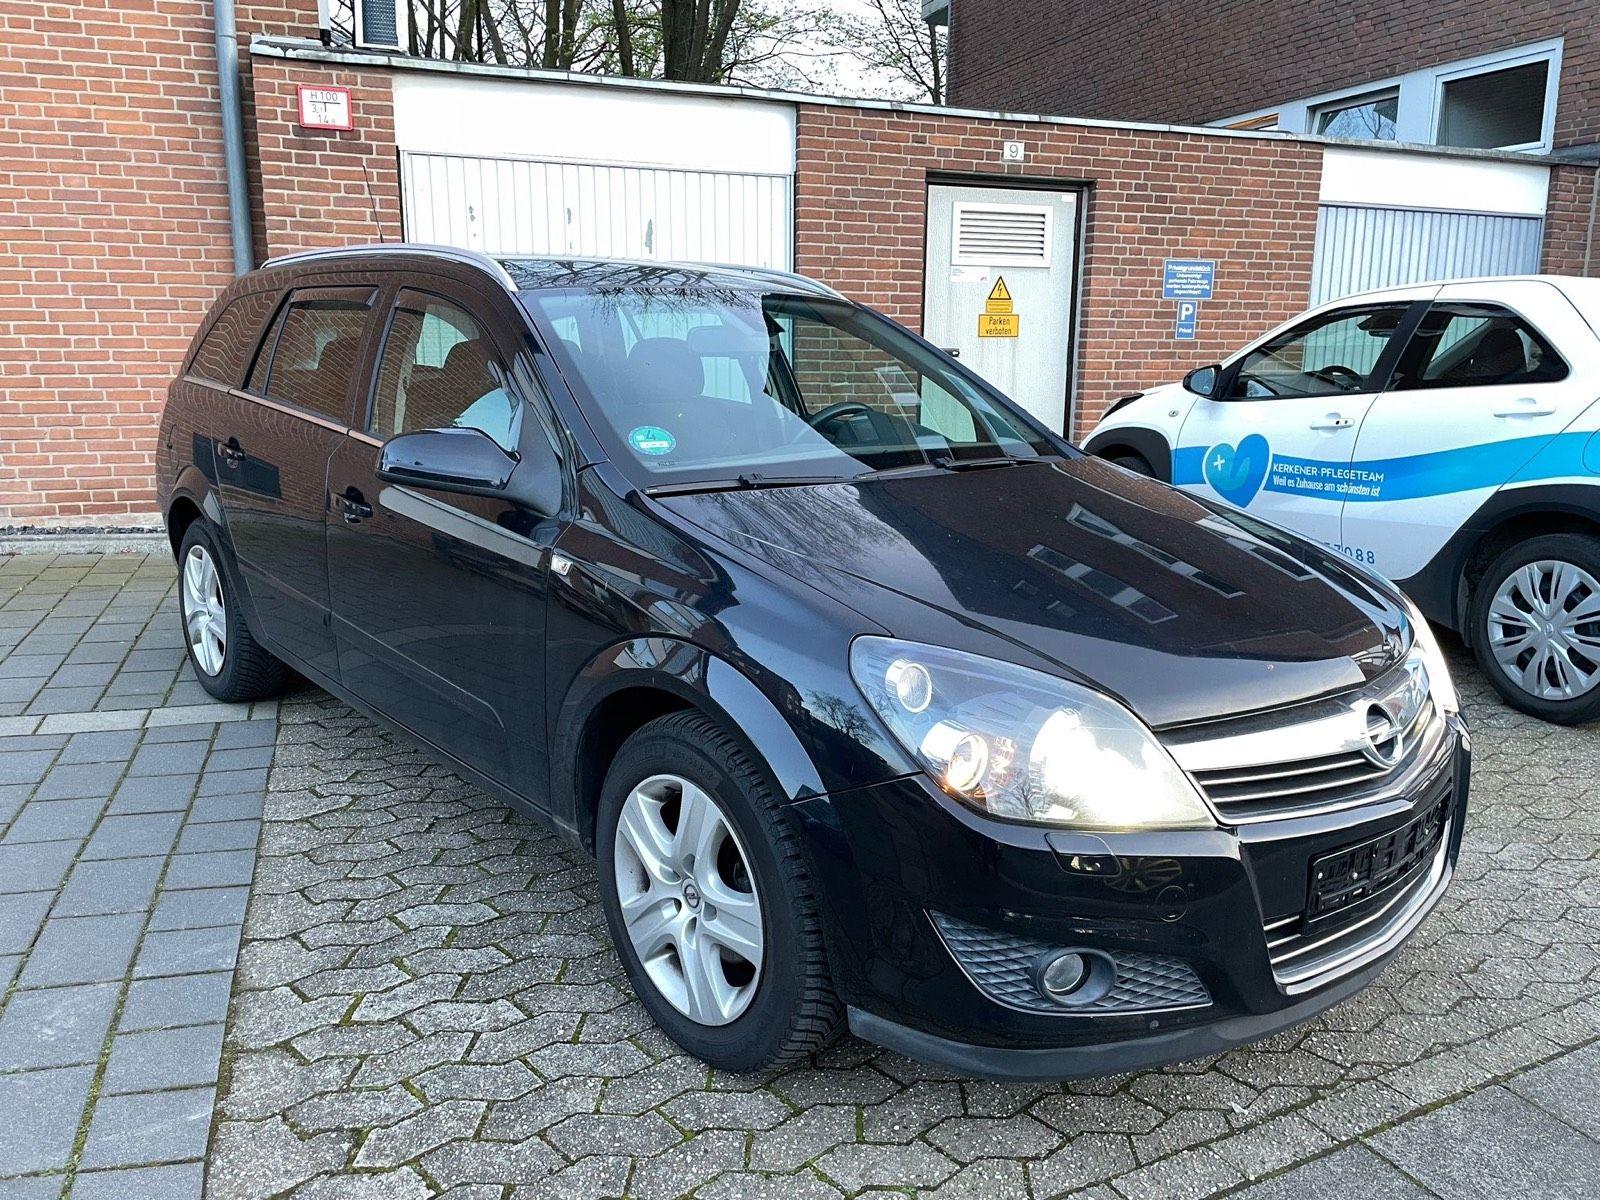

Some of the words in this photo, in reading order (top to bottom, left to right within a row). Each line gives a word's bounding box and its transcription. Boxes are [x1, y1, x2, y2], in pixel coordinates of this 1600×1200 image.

[1009, 144, 1018, 158] 9
[1181, 304, 1193, 320] P
[989, 316, 1010, 325] Parken
[985, 327, 1012, 335] verboten
[1273, 475, 1287, 486] Weil
[1287, 479, 1295, 488] es
[1296, 478, 1323, 490] Zuhause
[1324, 483, 1335, 491] am
[1370, 486, 1381, 497] ist
